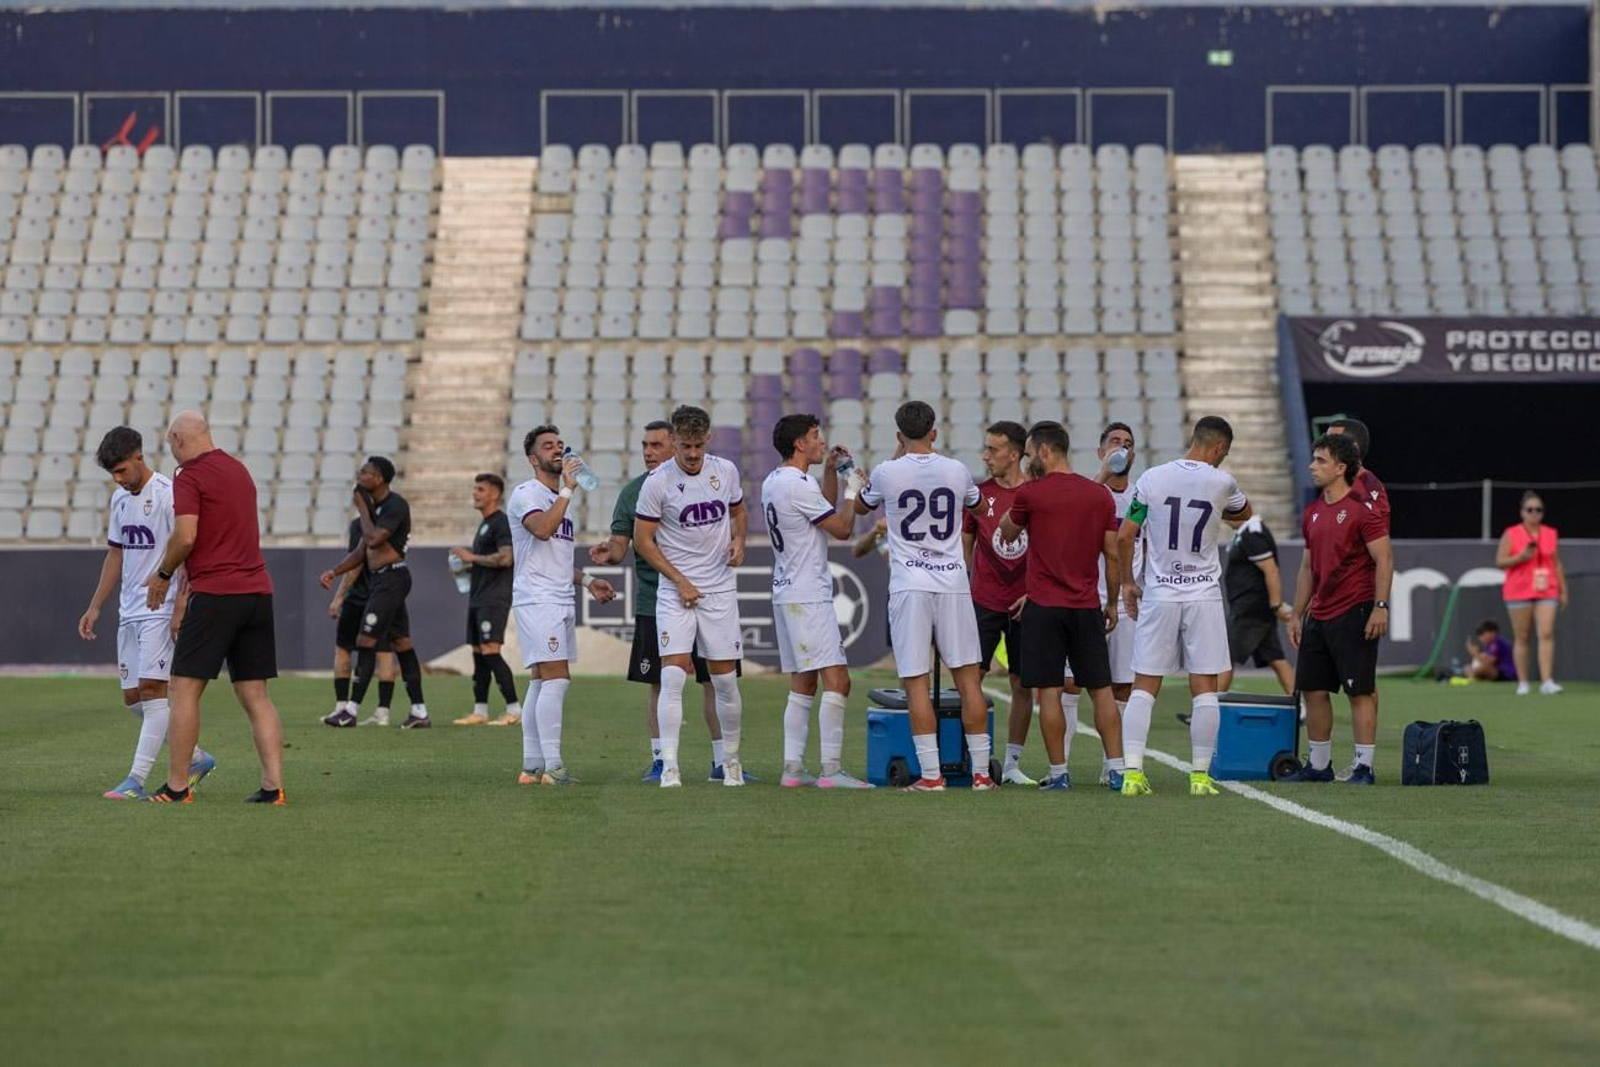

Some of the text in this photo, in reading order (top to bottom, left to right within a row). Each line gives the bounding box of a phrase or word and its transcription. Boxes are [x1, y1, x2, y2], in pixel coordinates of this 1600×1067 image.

[1446, 330, 1600, 350] PROTECCI
[1446, 353, 1467, 372] Y
[898, 487, 956, 542] 29
[1164, 496, 1213, 553] 17
